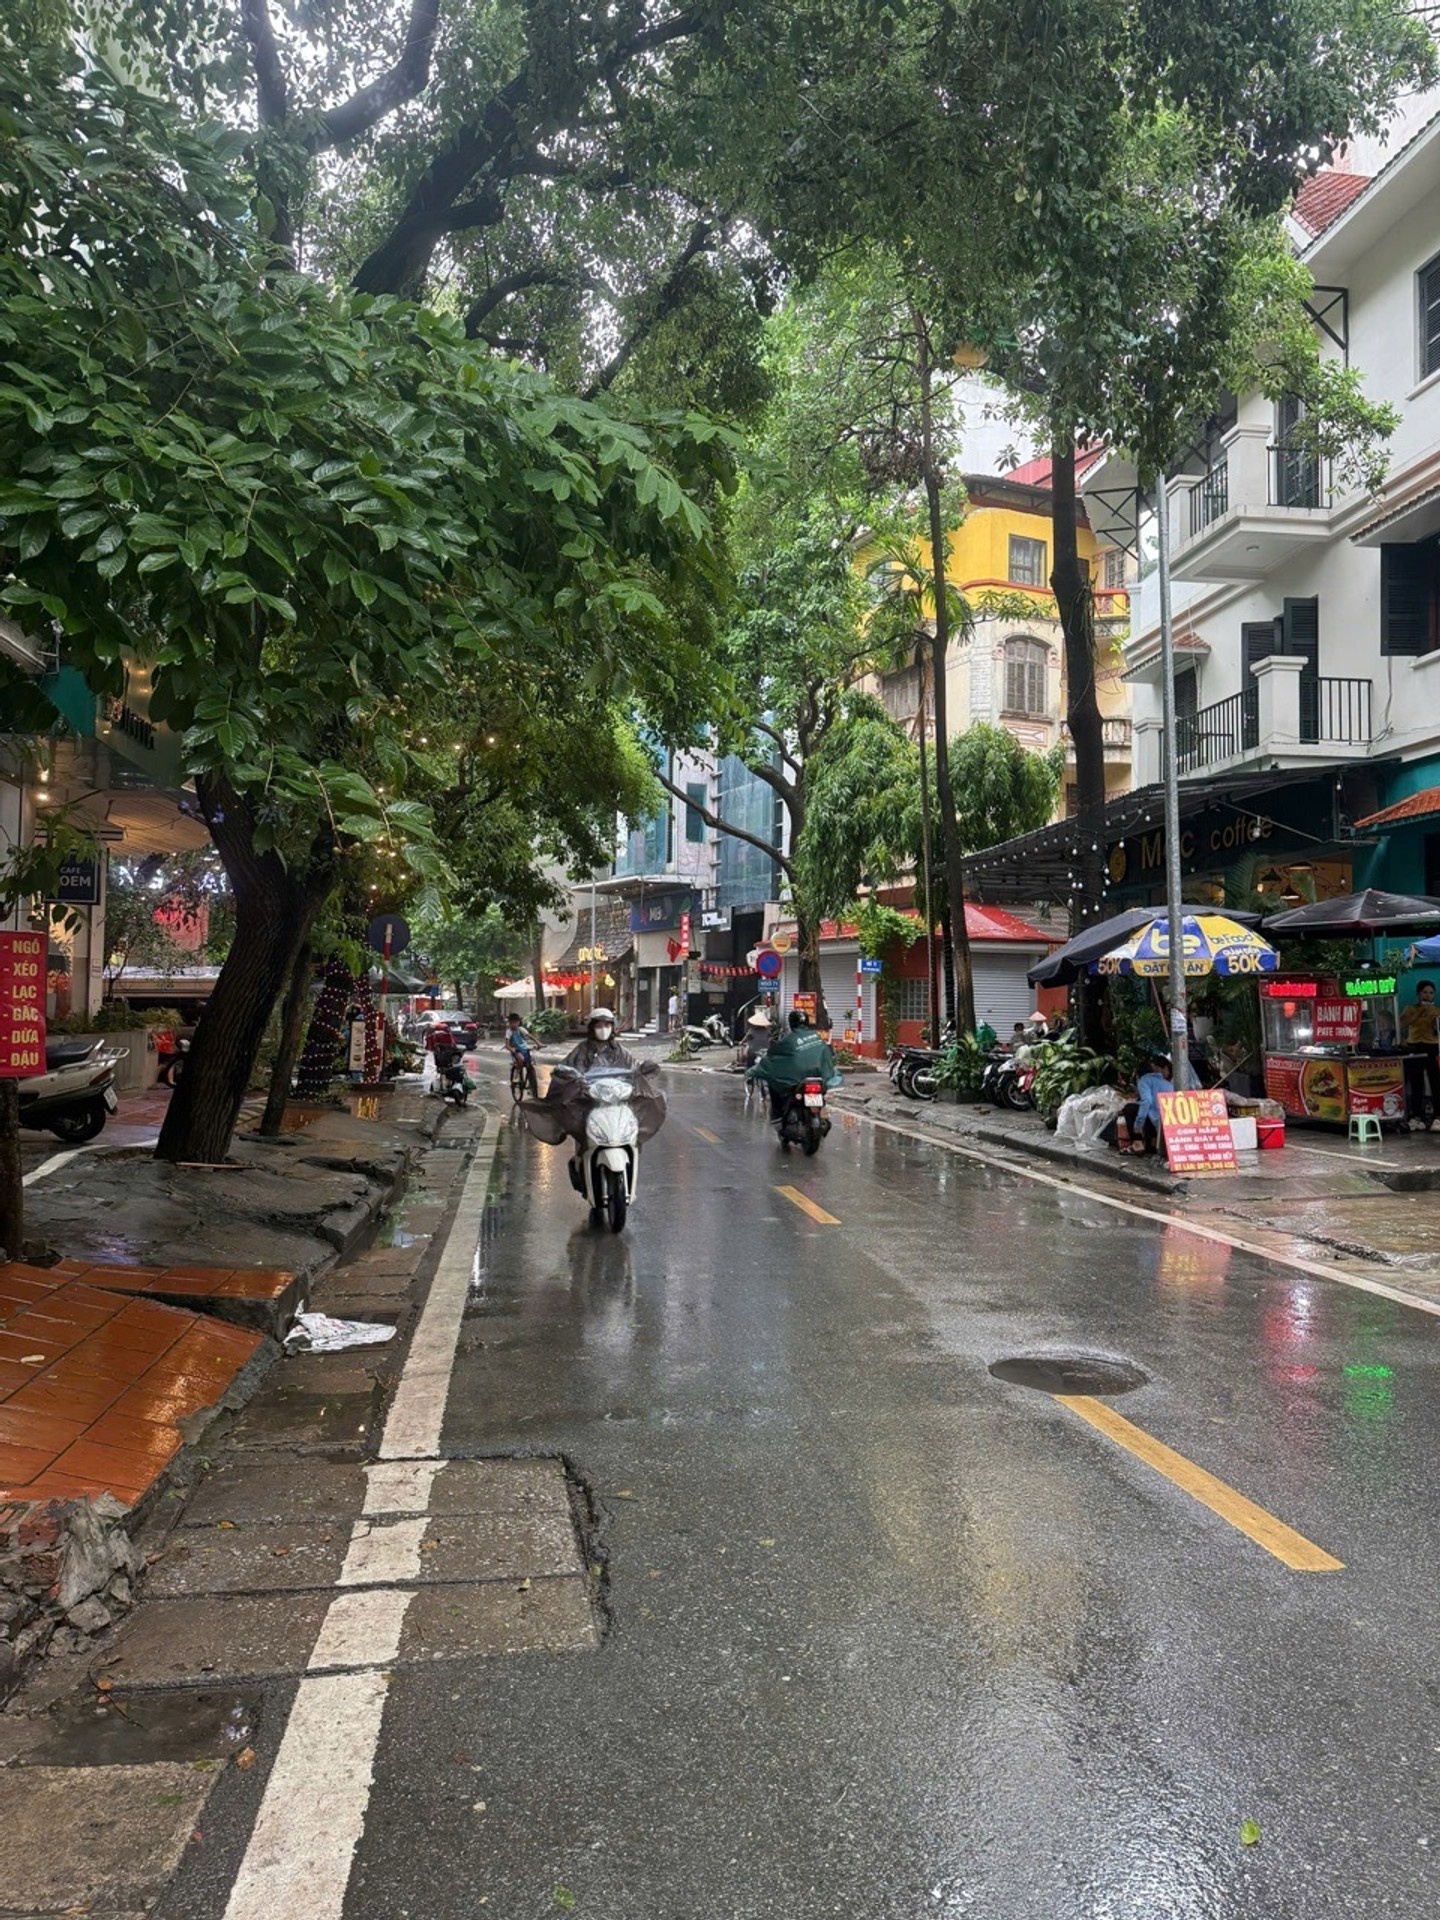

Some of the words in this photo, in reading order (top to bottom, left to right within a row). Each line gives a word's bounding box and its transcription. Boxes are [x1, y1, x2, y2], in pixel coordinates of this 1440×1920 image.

[1141, 831, 1195, 870] MC
[1210, 815, 1273, 850] coffee
[1151, 928, 1201, 955] be
[13, 961, 38, 977] XÉO
[1097, 958, 1121, 974] 50K
[1228, 954, 1264, 974] 50K
[12, 985, 37, 1002] LẠC
[1317, 1003, 1341, 1022] BÁNH
[12, 1029, 39, 1043] DỪA
[11, 1051, 39, 1069] ĐẬU
[1160, 1091, 1199, 1125] XÔI
